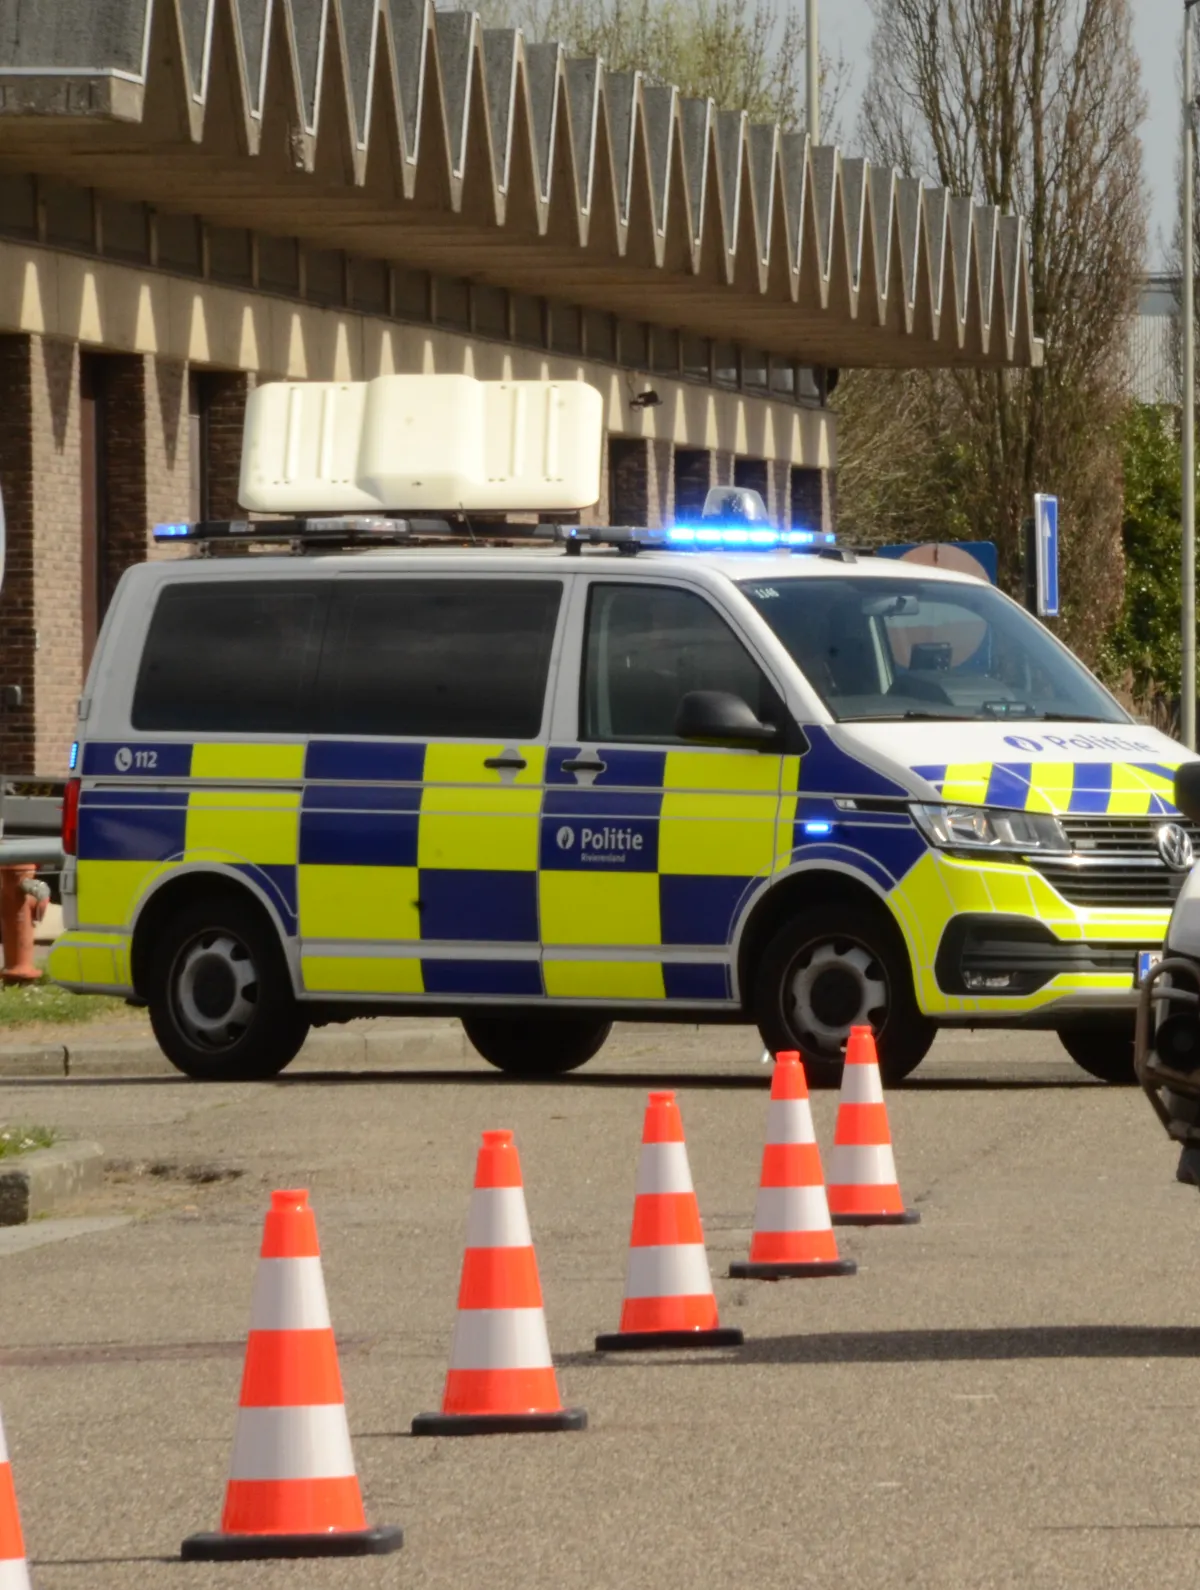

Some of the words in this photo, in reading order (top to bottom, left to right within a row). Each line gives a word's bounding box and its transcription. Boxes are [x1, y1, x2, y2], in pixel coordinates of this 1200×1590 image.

[1042, 734, 1160, 752] Politie
[135, 751, 158, 768] 112
[581, 827, 643, 850] Politie
